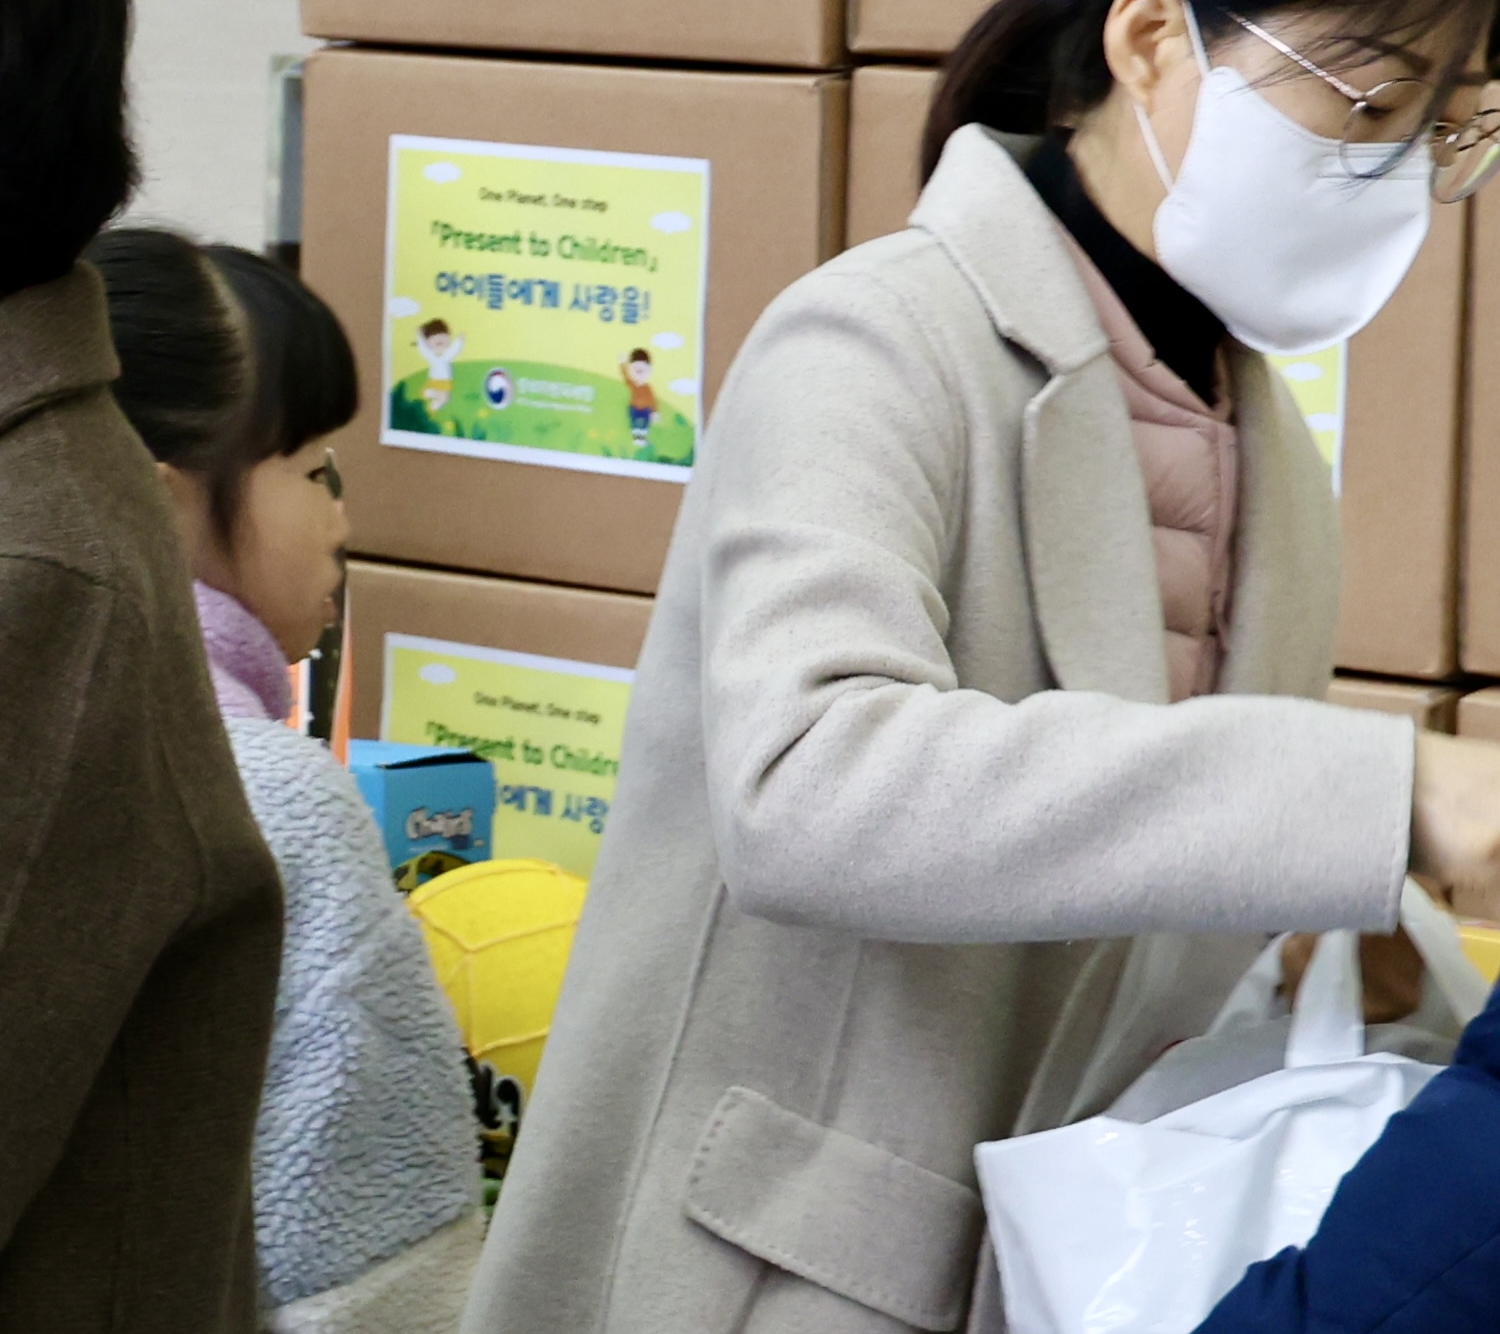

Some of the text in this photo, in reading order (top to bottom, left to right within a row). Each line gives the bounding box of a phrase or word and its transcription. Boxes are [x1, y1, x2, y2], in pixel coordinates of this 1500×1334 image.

[529, 232, 550, 258] to
[435, 270, 650, 324] 아이들에게 사랑을!
[523, 740, 543, 766] to
